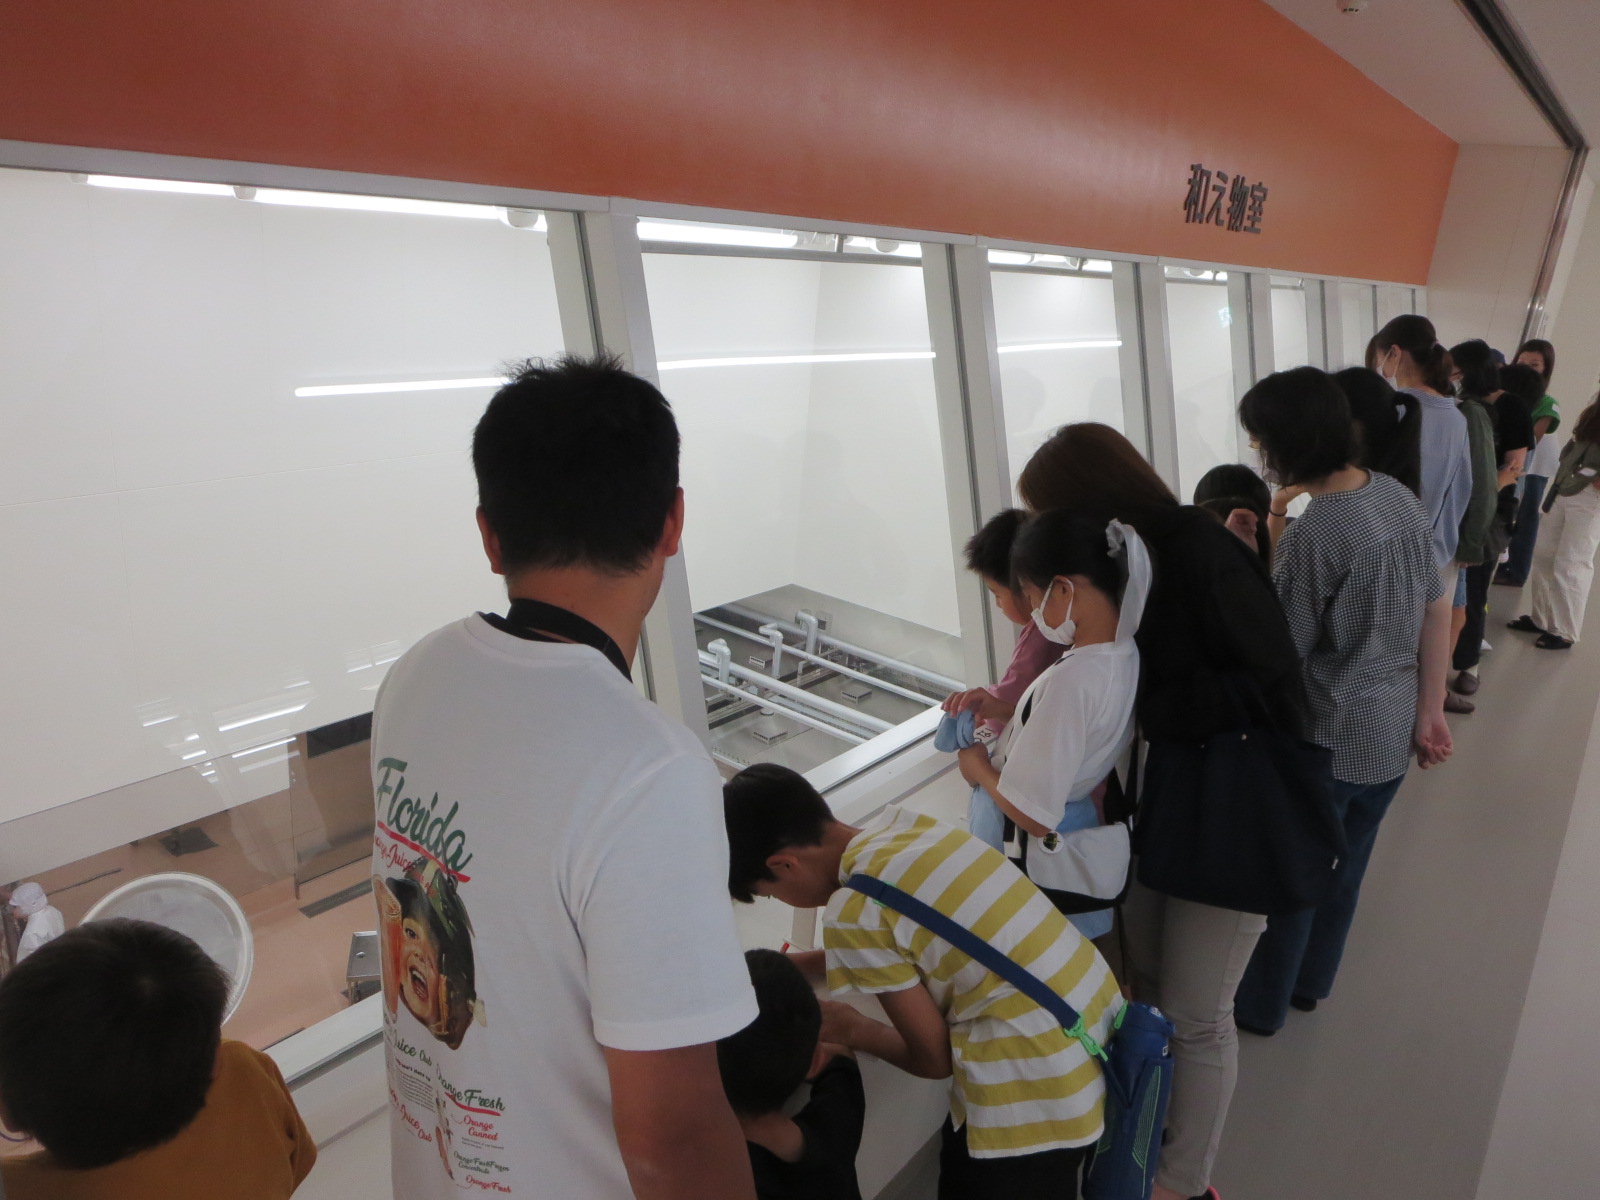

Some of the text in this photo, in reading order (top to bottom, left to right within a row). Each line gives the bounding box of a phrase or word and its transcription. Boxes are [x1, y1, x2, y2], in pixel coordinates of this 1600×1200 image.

[1183, 163, 1269, 235] 和え物室
[376, 757, 473, 872] Florida
[463, 1088, 506, 1112] Fresh
[463, 1114, 494, 1132] Orange
[468, 1126, 499, 1141] Canned
